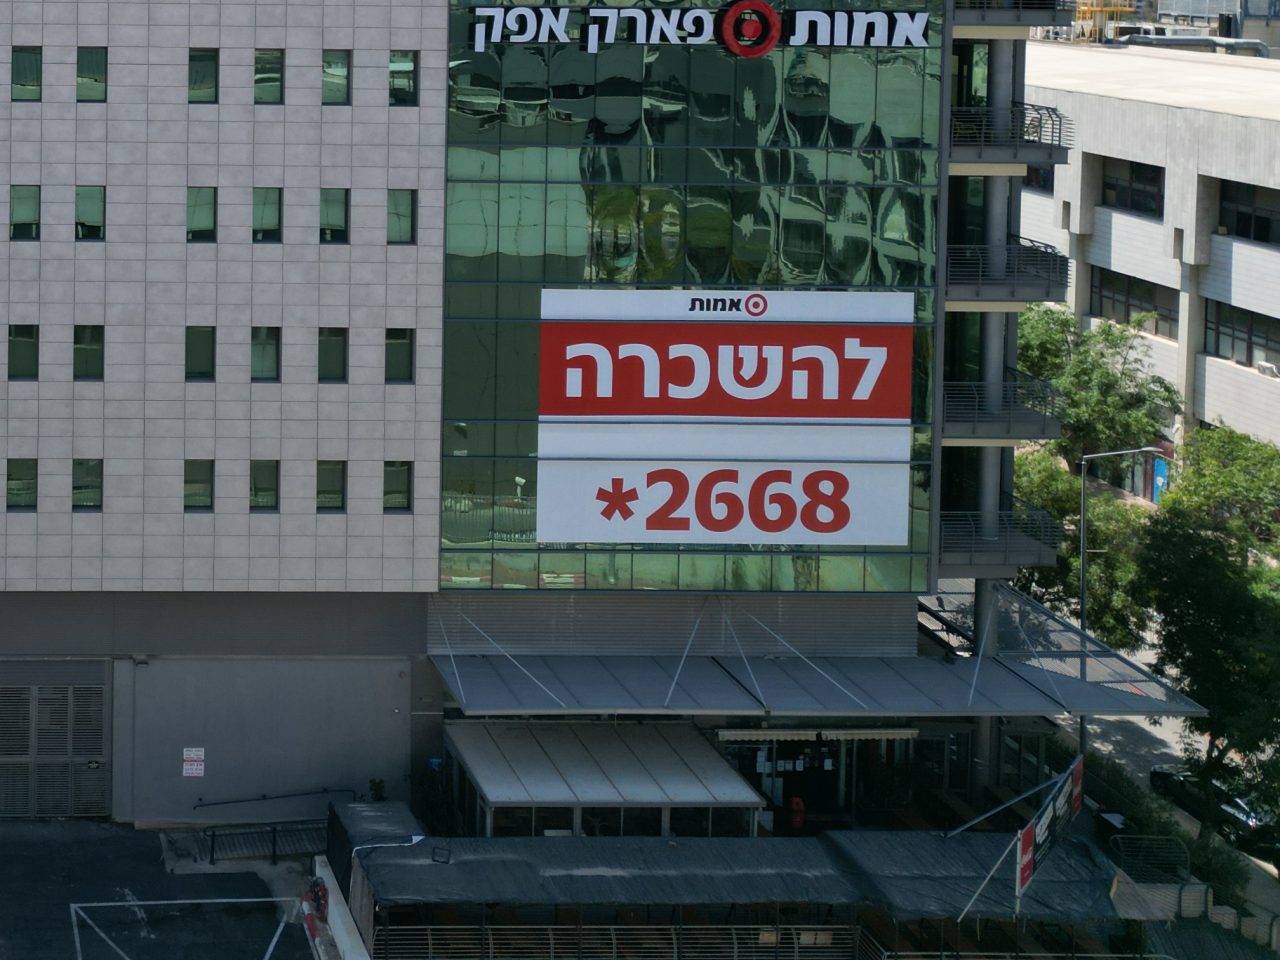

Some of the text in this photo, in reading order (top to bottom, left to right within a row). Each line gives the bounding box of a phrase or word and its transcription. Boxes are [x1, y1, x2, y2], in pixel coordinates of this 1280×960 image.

[474, 7, 930, 54] אמות פארק אפק
[688, 296, 742, 313] אמות
[565, 337, 888, 401] להשכרה
